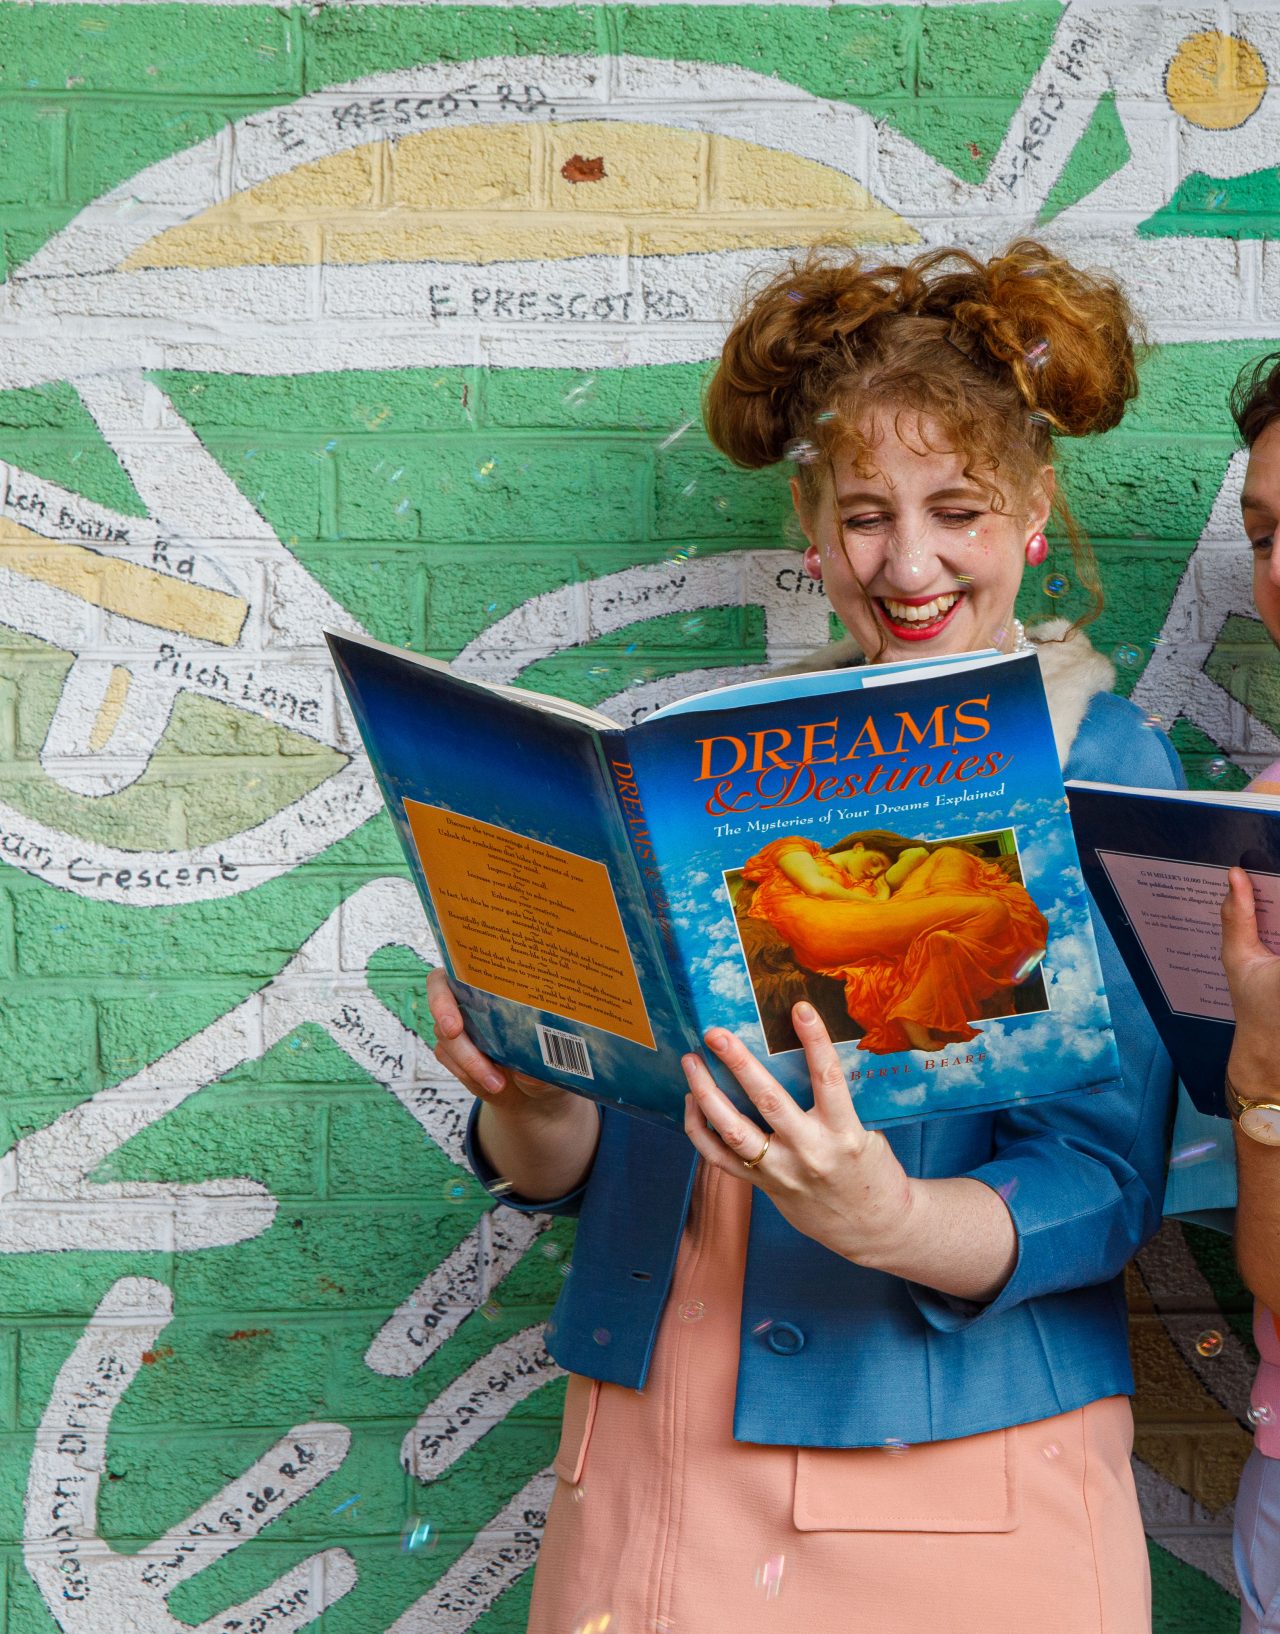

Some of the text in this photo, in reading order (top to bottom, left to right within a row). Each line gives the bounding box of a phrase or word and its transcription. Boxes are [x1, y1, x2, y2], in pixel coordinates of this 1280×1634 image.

[276, 112, 305, 150] E
[429, 284, 692, 320] E PRESCOT RD
[152, 537, 195, 577] Rd
[694, 693, 991, 782] DREAMS
[611, 759, 657, 861] DREAMS
[705, 749, 1015, 817] & Destinies
[714, 782, 1006, 838] The Mysteries of Your Dreams Explained
[0, 830, 241, 891] am Crescent
[850, 1051, 988, 1082] BERYL BEARE
